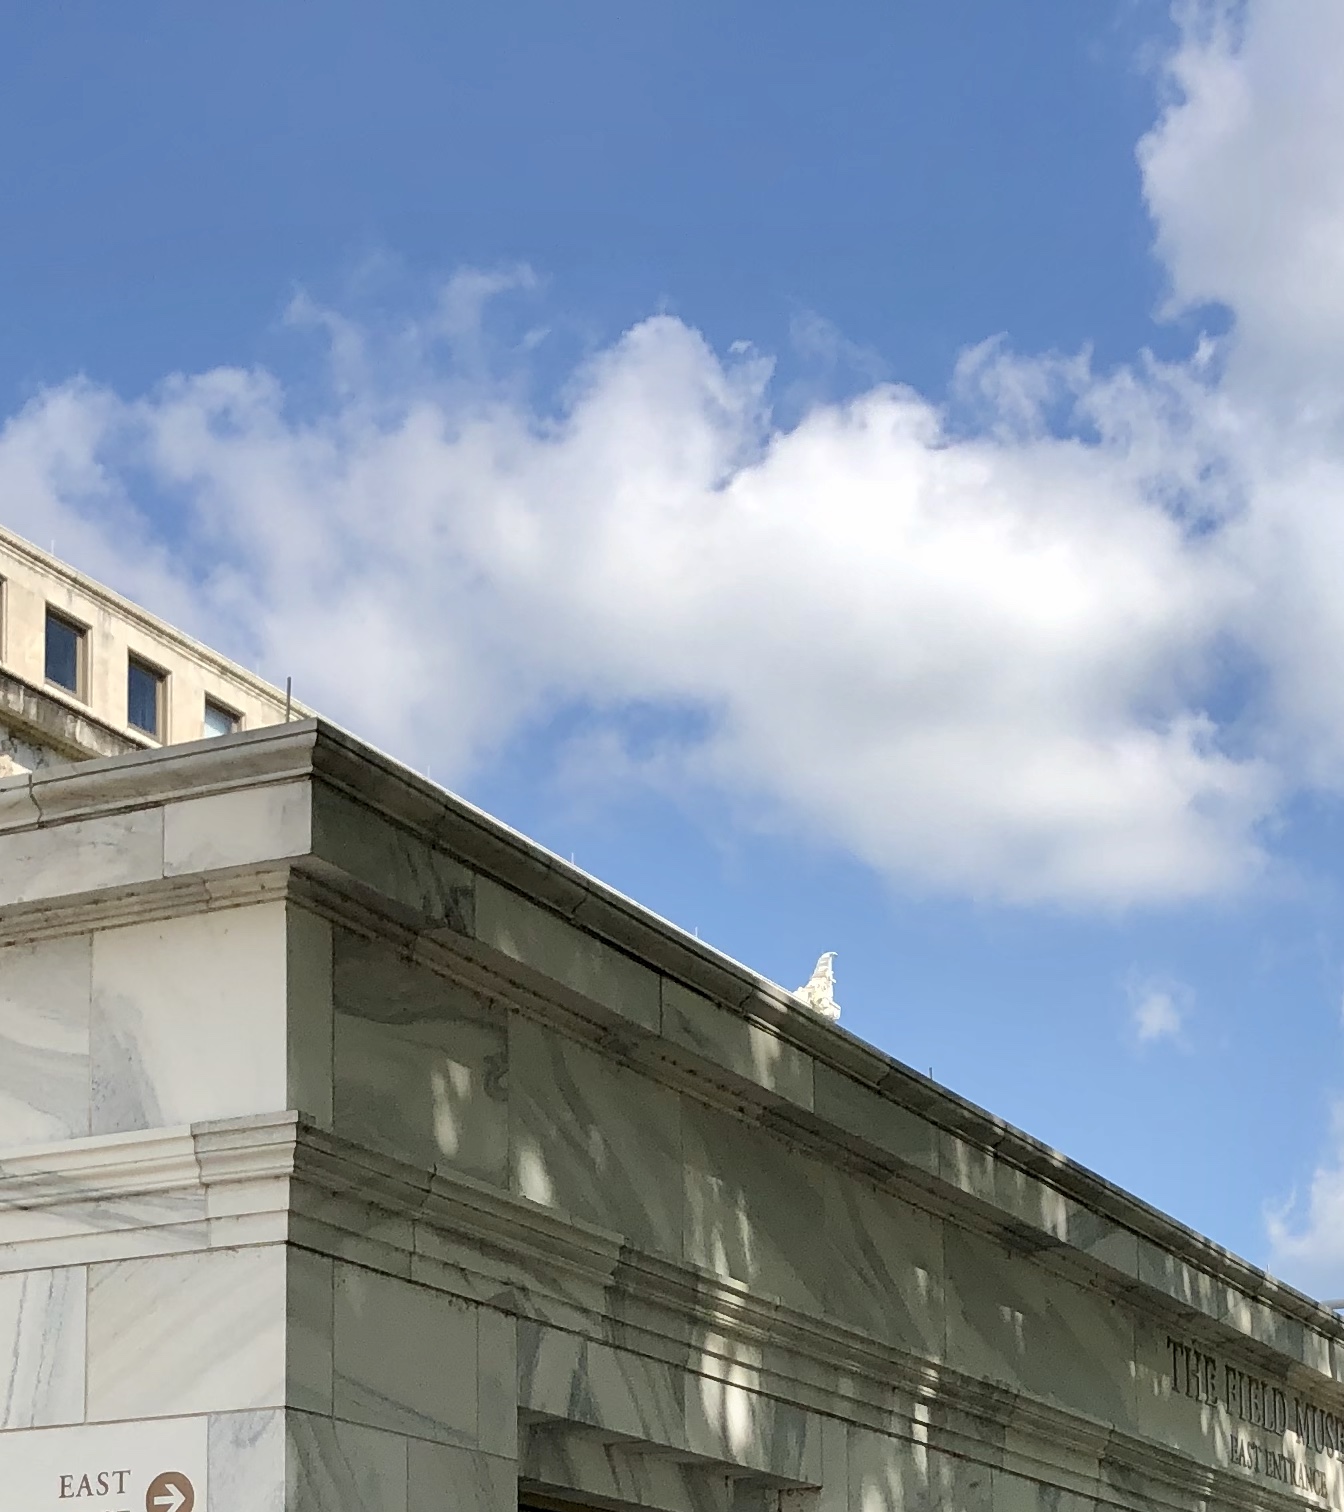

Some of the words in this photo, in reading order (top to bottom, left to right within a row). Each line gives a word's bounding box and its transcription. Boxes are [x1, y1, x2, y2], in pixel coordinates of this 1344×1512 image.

[1166, 1335, 1218, 1408] THE
[1225, 1364, 1289, 1437] FIELD
[59, 1469, 132, 1499] EAST
[1229, 1433, 1261, 1473] EAST
[1265, 1448, 1329, 1499] ENTRANCE
